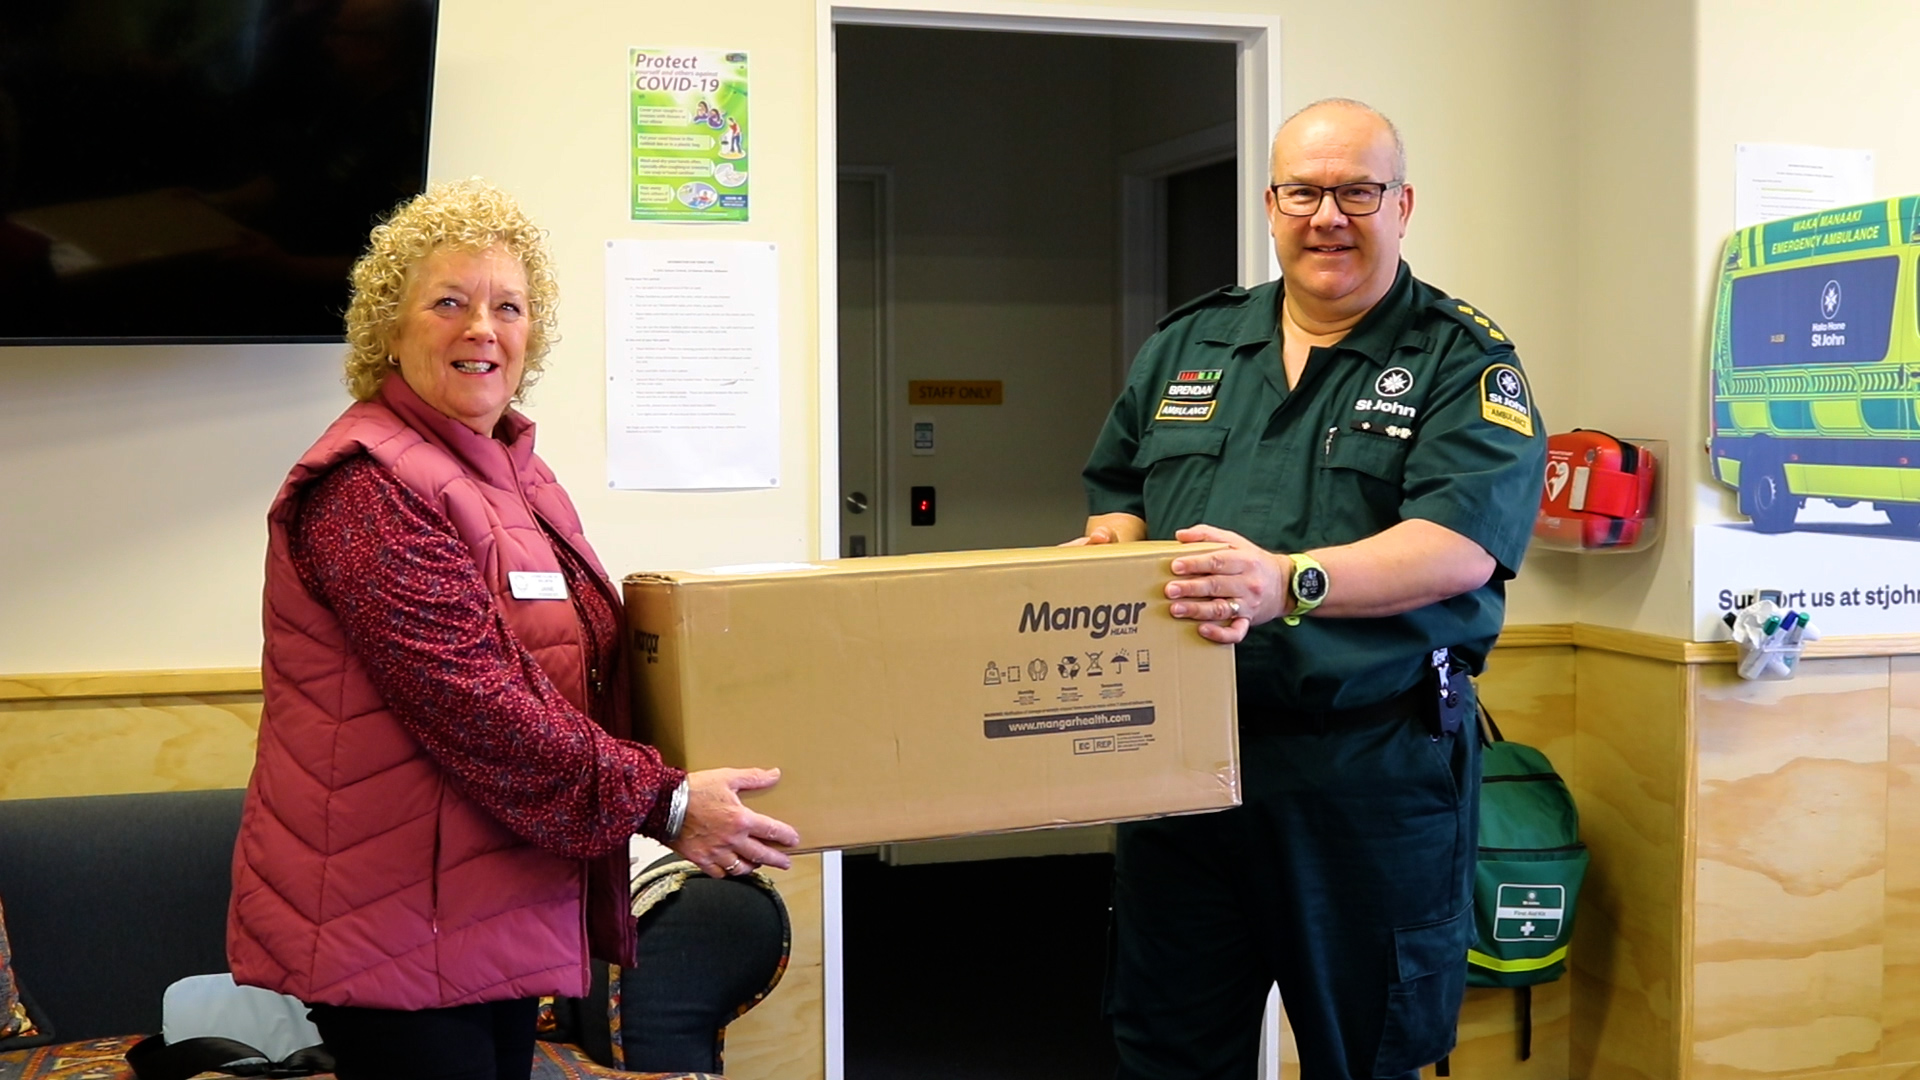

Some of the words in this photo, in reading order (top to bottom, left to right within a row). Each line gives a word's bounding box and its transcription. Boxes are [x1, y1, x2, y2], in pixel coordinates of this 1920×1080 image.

[636, 54, 698, 69] Protect
[636, 76, 720, 92] COVID-19
[1792, 215, 1818, 232] WAKA
[1820, 210, 1862, 226] MANAAKI
[1771, 236, 1821, 255] EMERGENCY
[1822, 226, 1879, 246] AMBULANCE
[1811, 334, 1822, 347] St
[1822, 333, 1845, 346] John
[919, 386, 955, 398] STAFF
[959, 387, 992, 399] ONLY
[1168, 385, 1214, 395] BRENDAN
[1162, 406, 1210, 416] AMBULANCE
[1355, 399, 1372, 412] St
[1373, 400, 1416, 418] John
[1488, 392, 1502, 403] St
[1502, 396, 1527, 414] John
[1491, 408, 1527, 428] AMBULANCE
[1812, 592, 1835, 607] us
[1840, 587, 1860, 606] at
[1018, 601, 1146, 639] Mangar
[1110, 627, 1138, 636] HEALTH
[1008, 713, 1131, 732] www.mangarhealth.com
[1079, 741, 1090, 751] EC
[1096, 739, 1112, 749] REP
